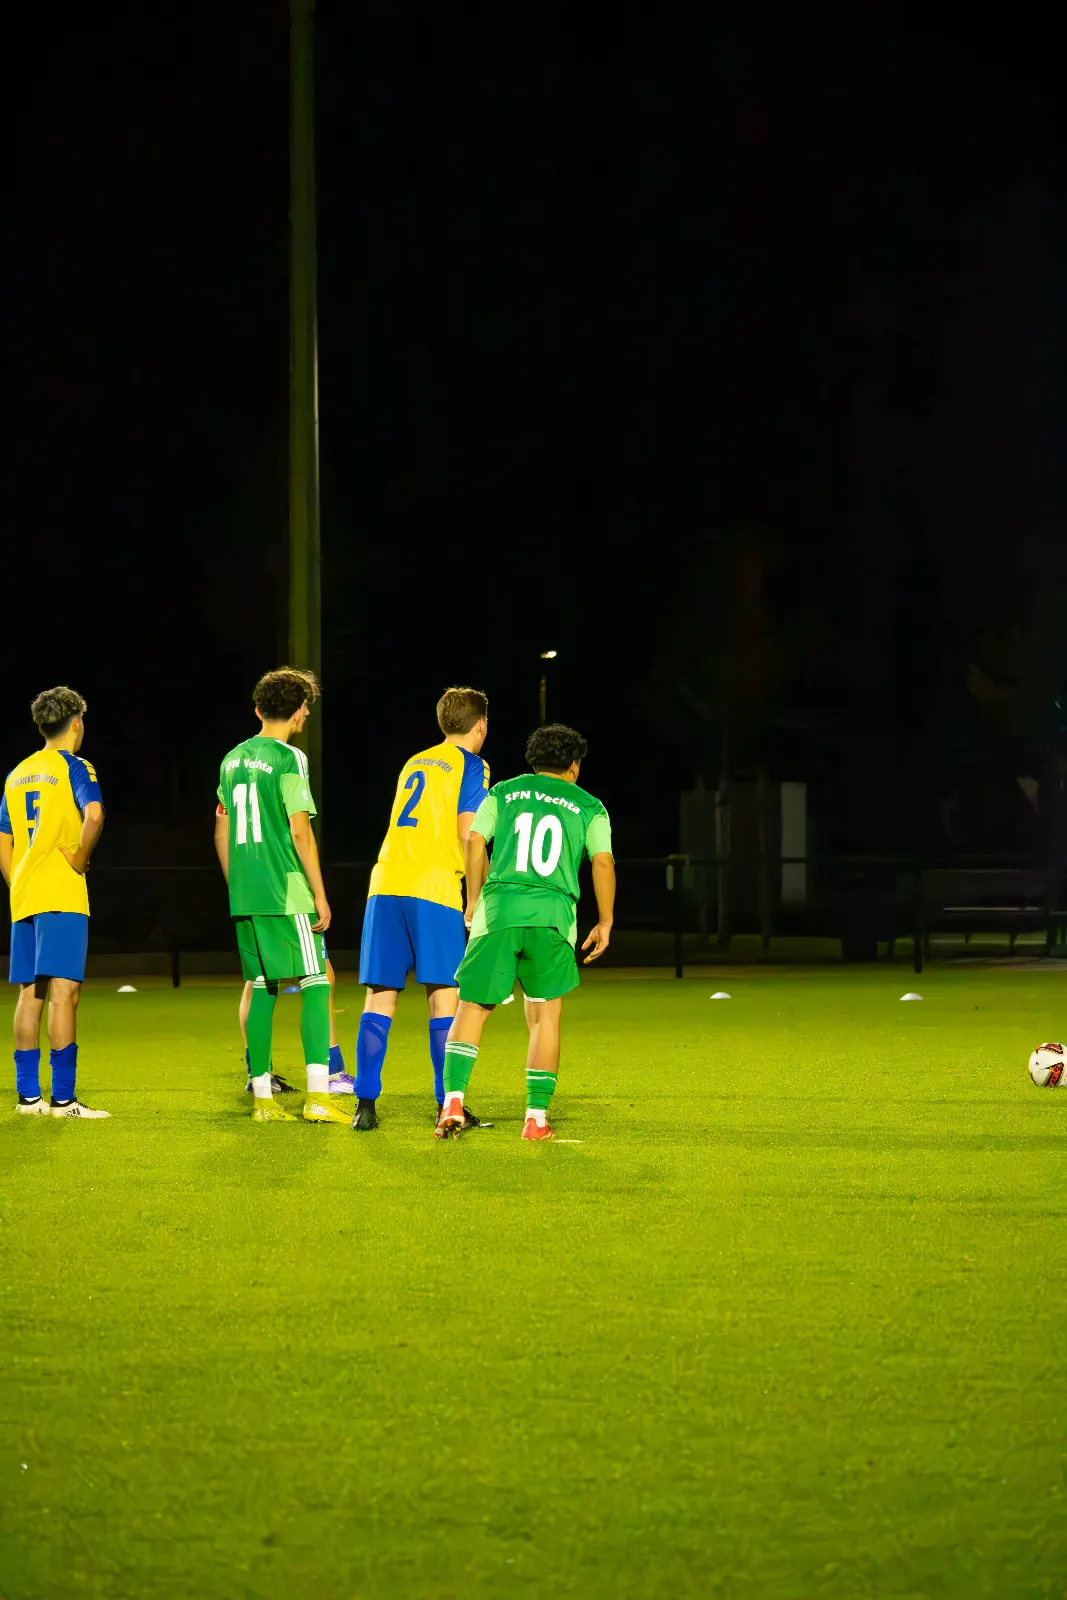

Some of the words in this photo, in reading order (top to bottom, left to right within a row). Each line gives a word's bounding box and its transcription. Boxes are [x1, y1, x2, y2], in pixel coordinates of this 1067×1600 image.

[25, 790, 41, 849] 5
[232, 781, 262, 845] 11
[397, 770, 426, 828] 2
[504, 790, 531, 804] SFN
[535, 791, 581, 815] Vechta
[514, 812, 563, 877] 10
